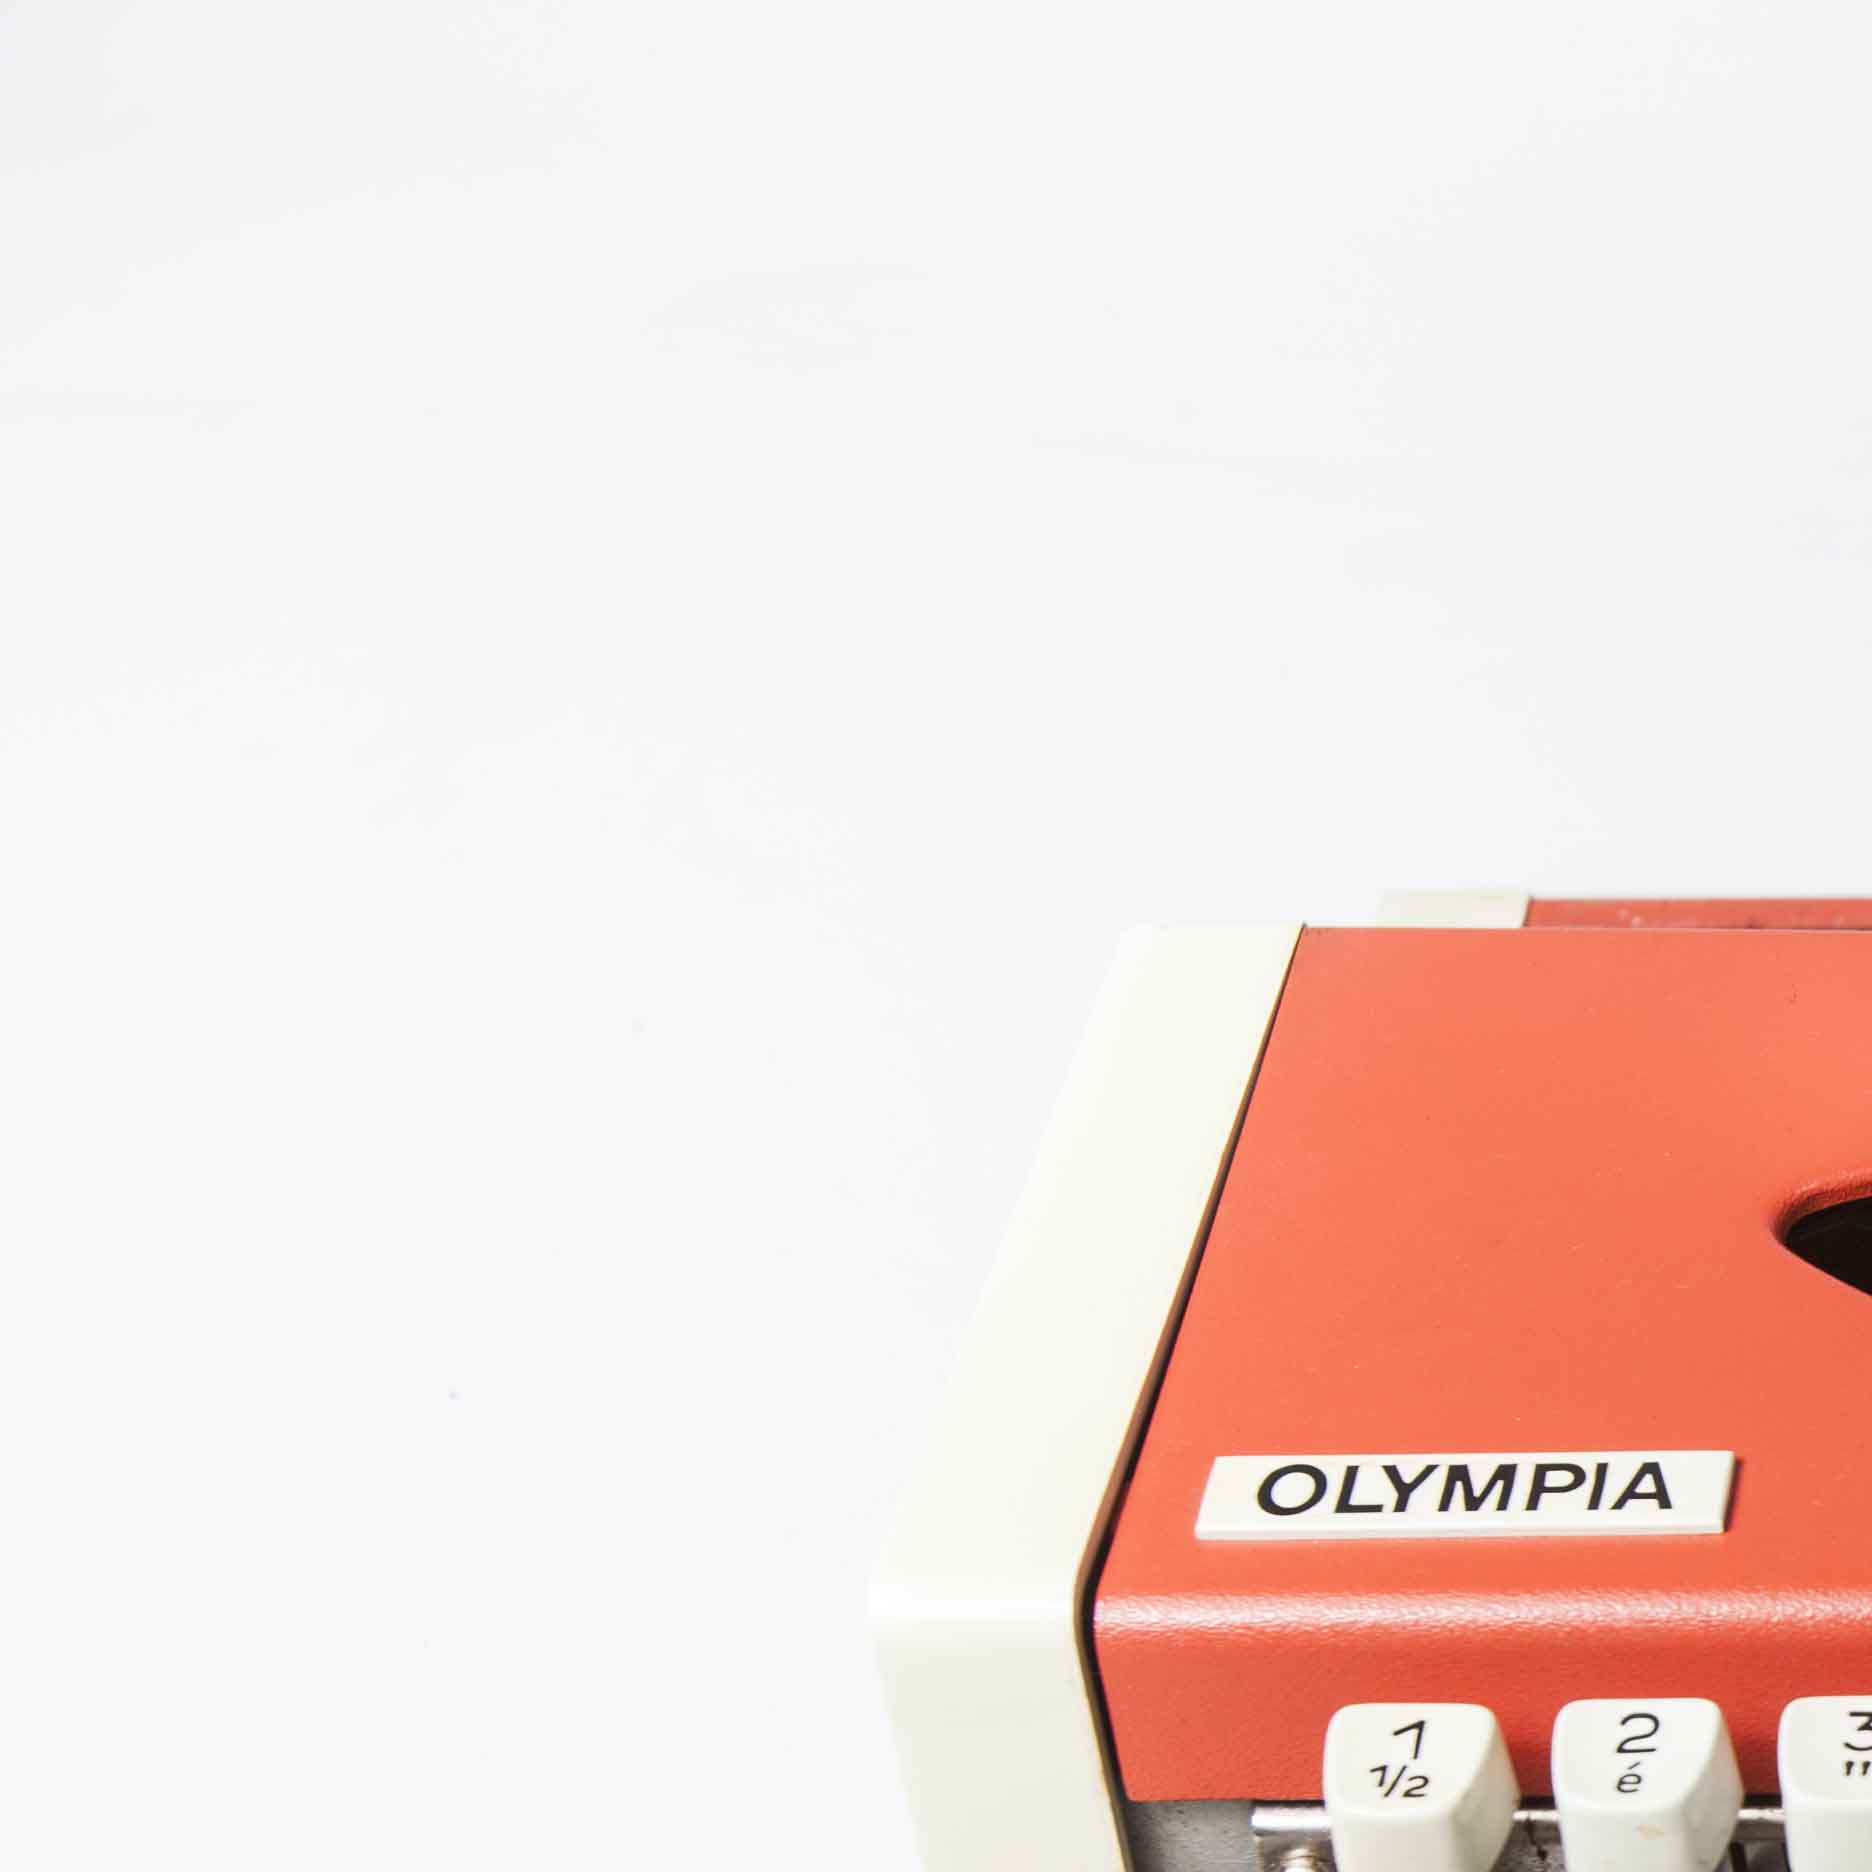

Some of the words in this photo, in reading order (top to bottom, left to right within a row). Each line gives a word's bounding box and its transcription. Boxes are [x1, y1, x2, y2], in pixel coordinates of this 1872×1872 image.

[1256, 1461, 1673, 1517] OLYMPIA
[1392, 1719, 1426, 1760] 1
[1616, 1712, 1660, 1754] 2
[1615, 1761, 1643, 1794] é
